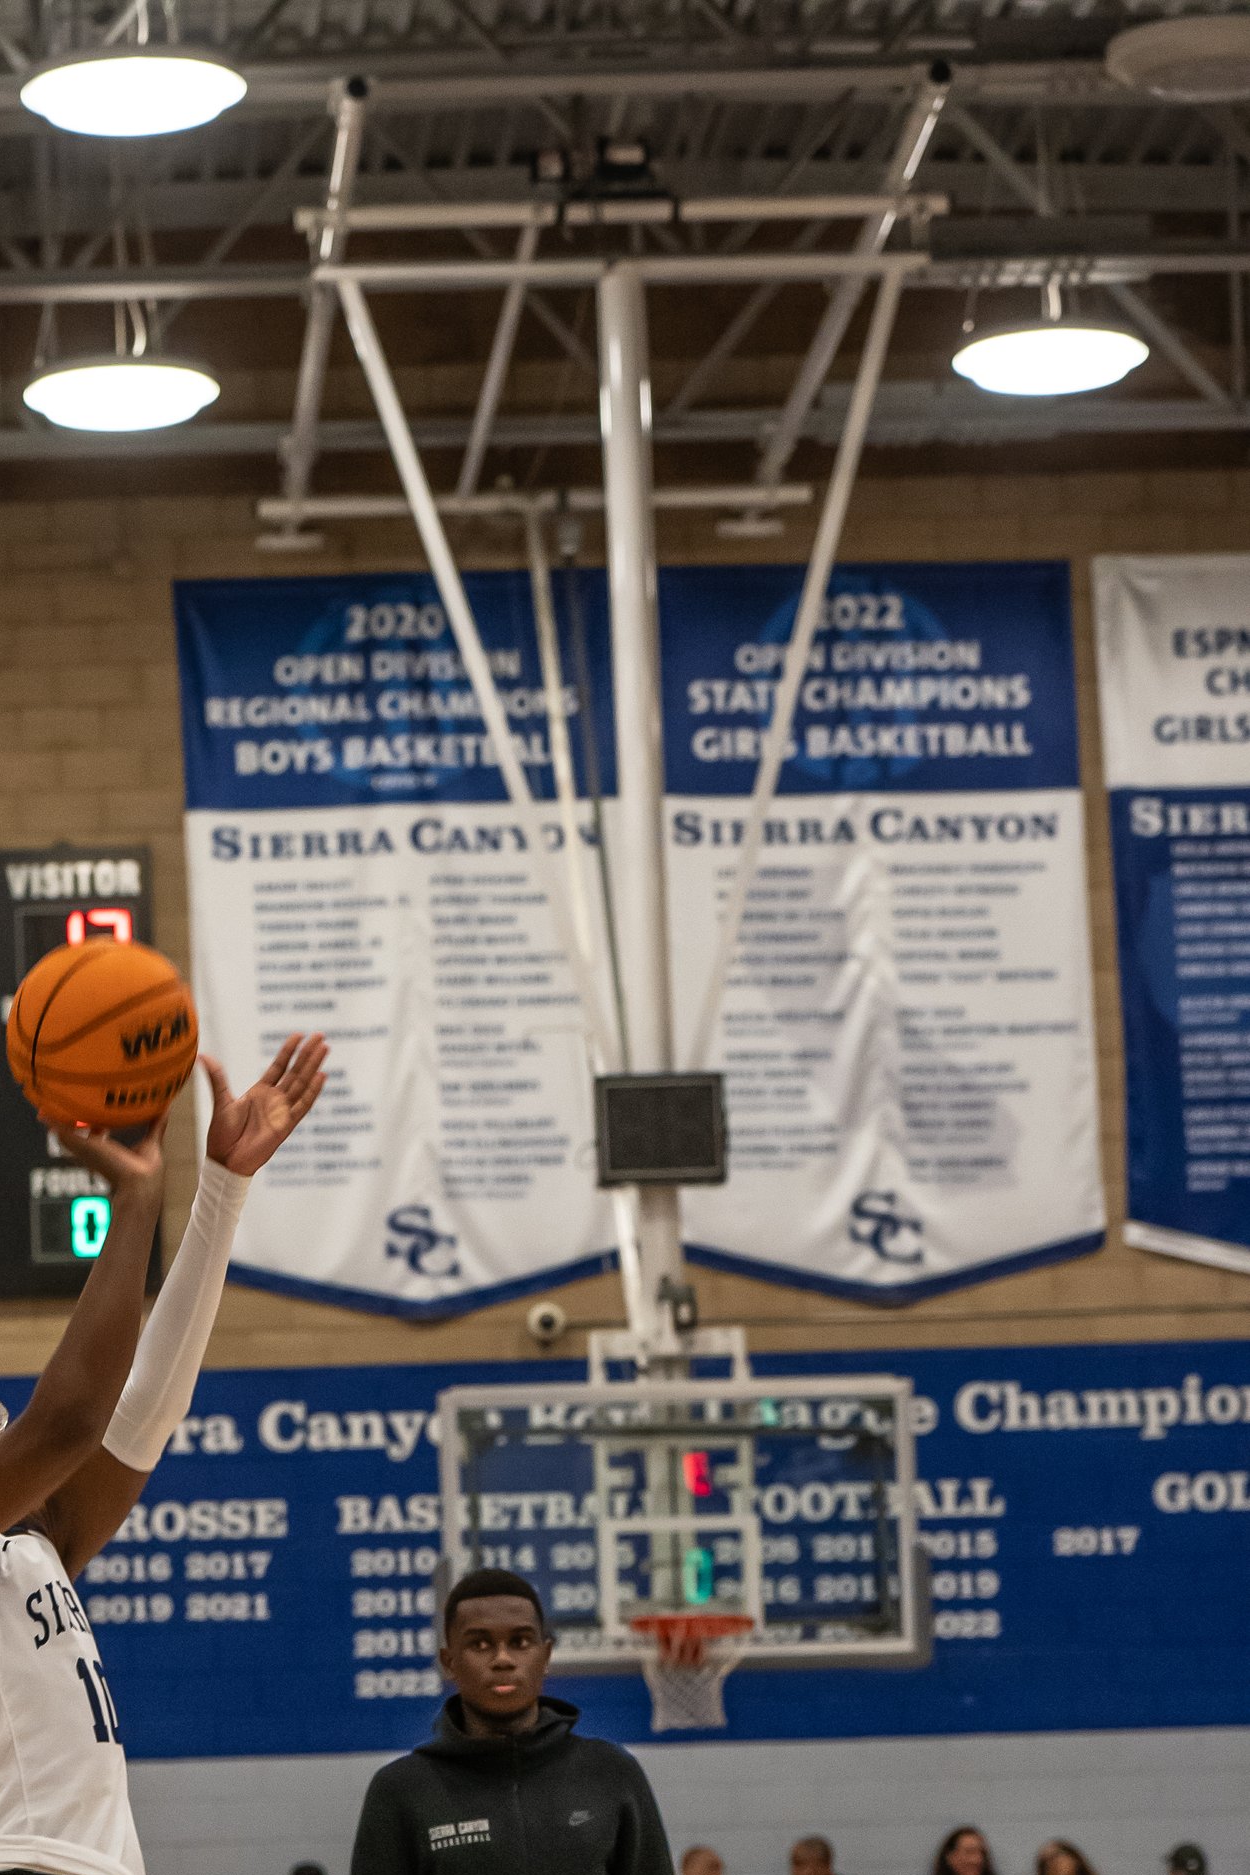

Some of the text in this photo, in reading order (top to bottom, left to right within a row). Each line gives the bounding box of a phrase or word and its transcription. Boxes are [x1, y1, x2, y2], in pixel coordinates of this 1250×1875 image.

[345, 604, 447, 642] 2020
[274, 653, 364, 686] OPEN
[734, 639, 981, 674] OPN DIVISION
[205, 694, 372, 727] REGIONAL
[687, 675, 1031, 715] STAT CHAMPIONS
[234, 740, 334, 776] BOYS
[805, 723, 1033, 760] BASKETBALL
[211, 825, 395, 861] SIERRA
[870, 807, 1059, 844] CANYON
[6, 860, 142, 899] VISITOR
[71, 1195, 112, 1258] 0
[1052, 1525, 1141, 1557] 2017
[184, 1550, 272, 1580] 2017
